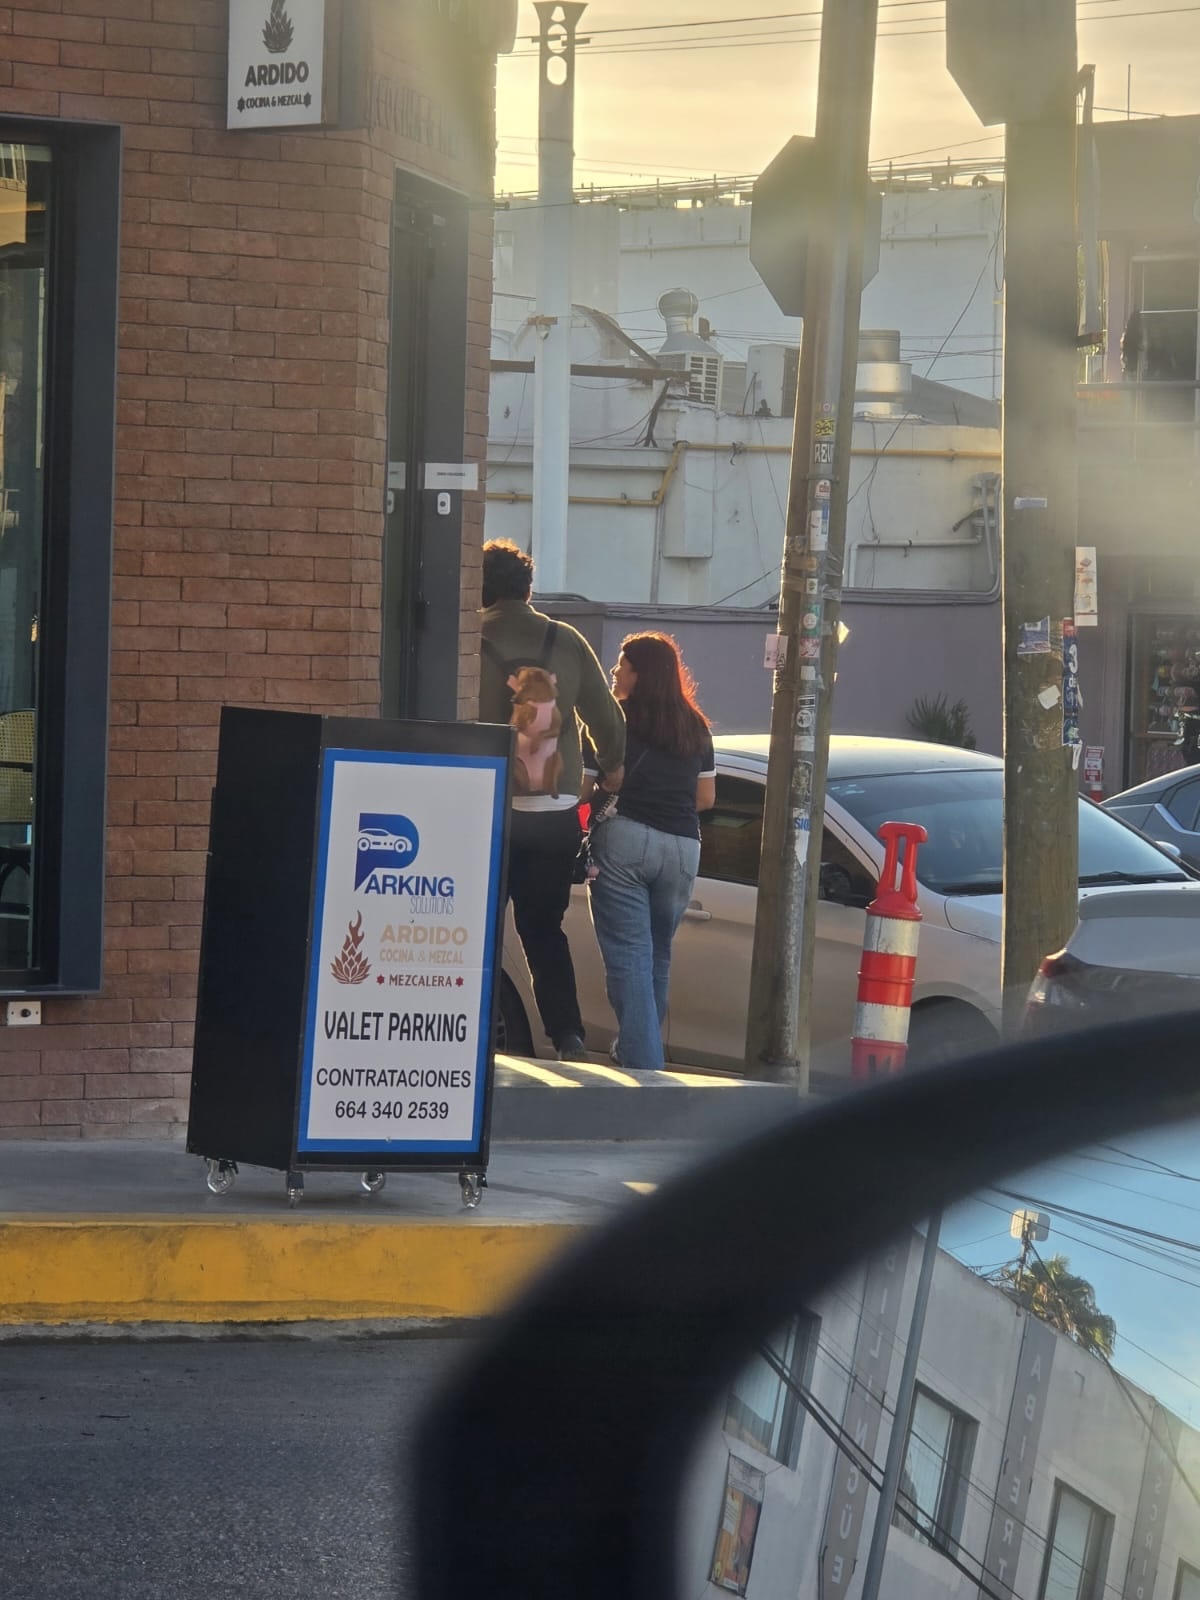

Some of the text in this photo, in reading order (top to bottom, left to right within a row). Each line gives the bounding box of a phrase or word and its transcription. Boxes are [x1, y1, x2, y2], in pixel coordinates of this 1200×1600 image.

[244, 61, 310, 87] ARDIDO
[245, 96, 271, 109] COCINA
[277, 94, 304, 107] MEZCAL
[409, 896, 455, 915] SOLUTIONS
[380, 924, 469, 946] ARDIDO
[379, 948, 464, 964] COCINA & MEZCAL
[388, 974, 453, 987] MEZCALERA
[324, 1011, 468, 1042] VALET PARKING
[316, 1068, 472, 1088] CONTRATACIONES
[335, 1100, 449, 1120] 664 340 2539
